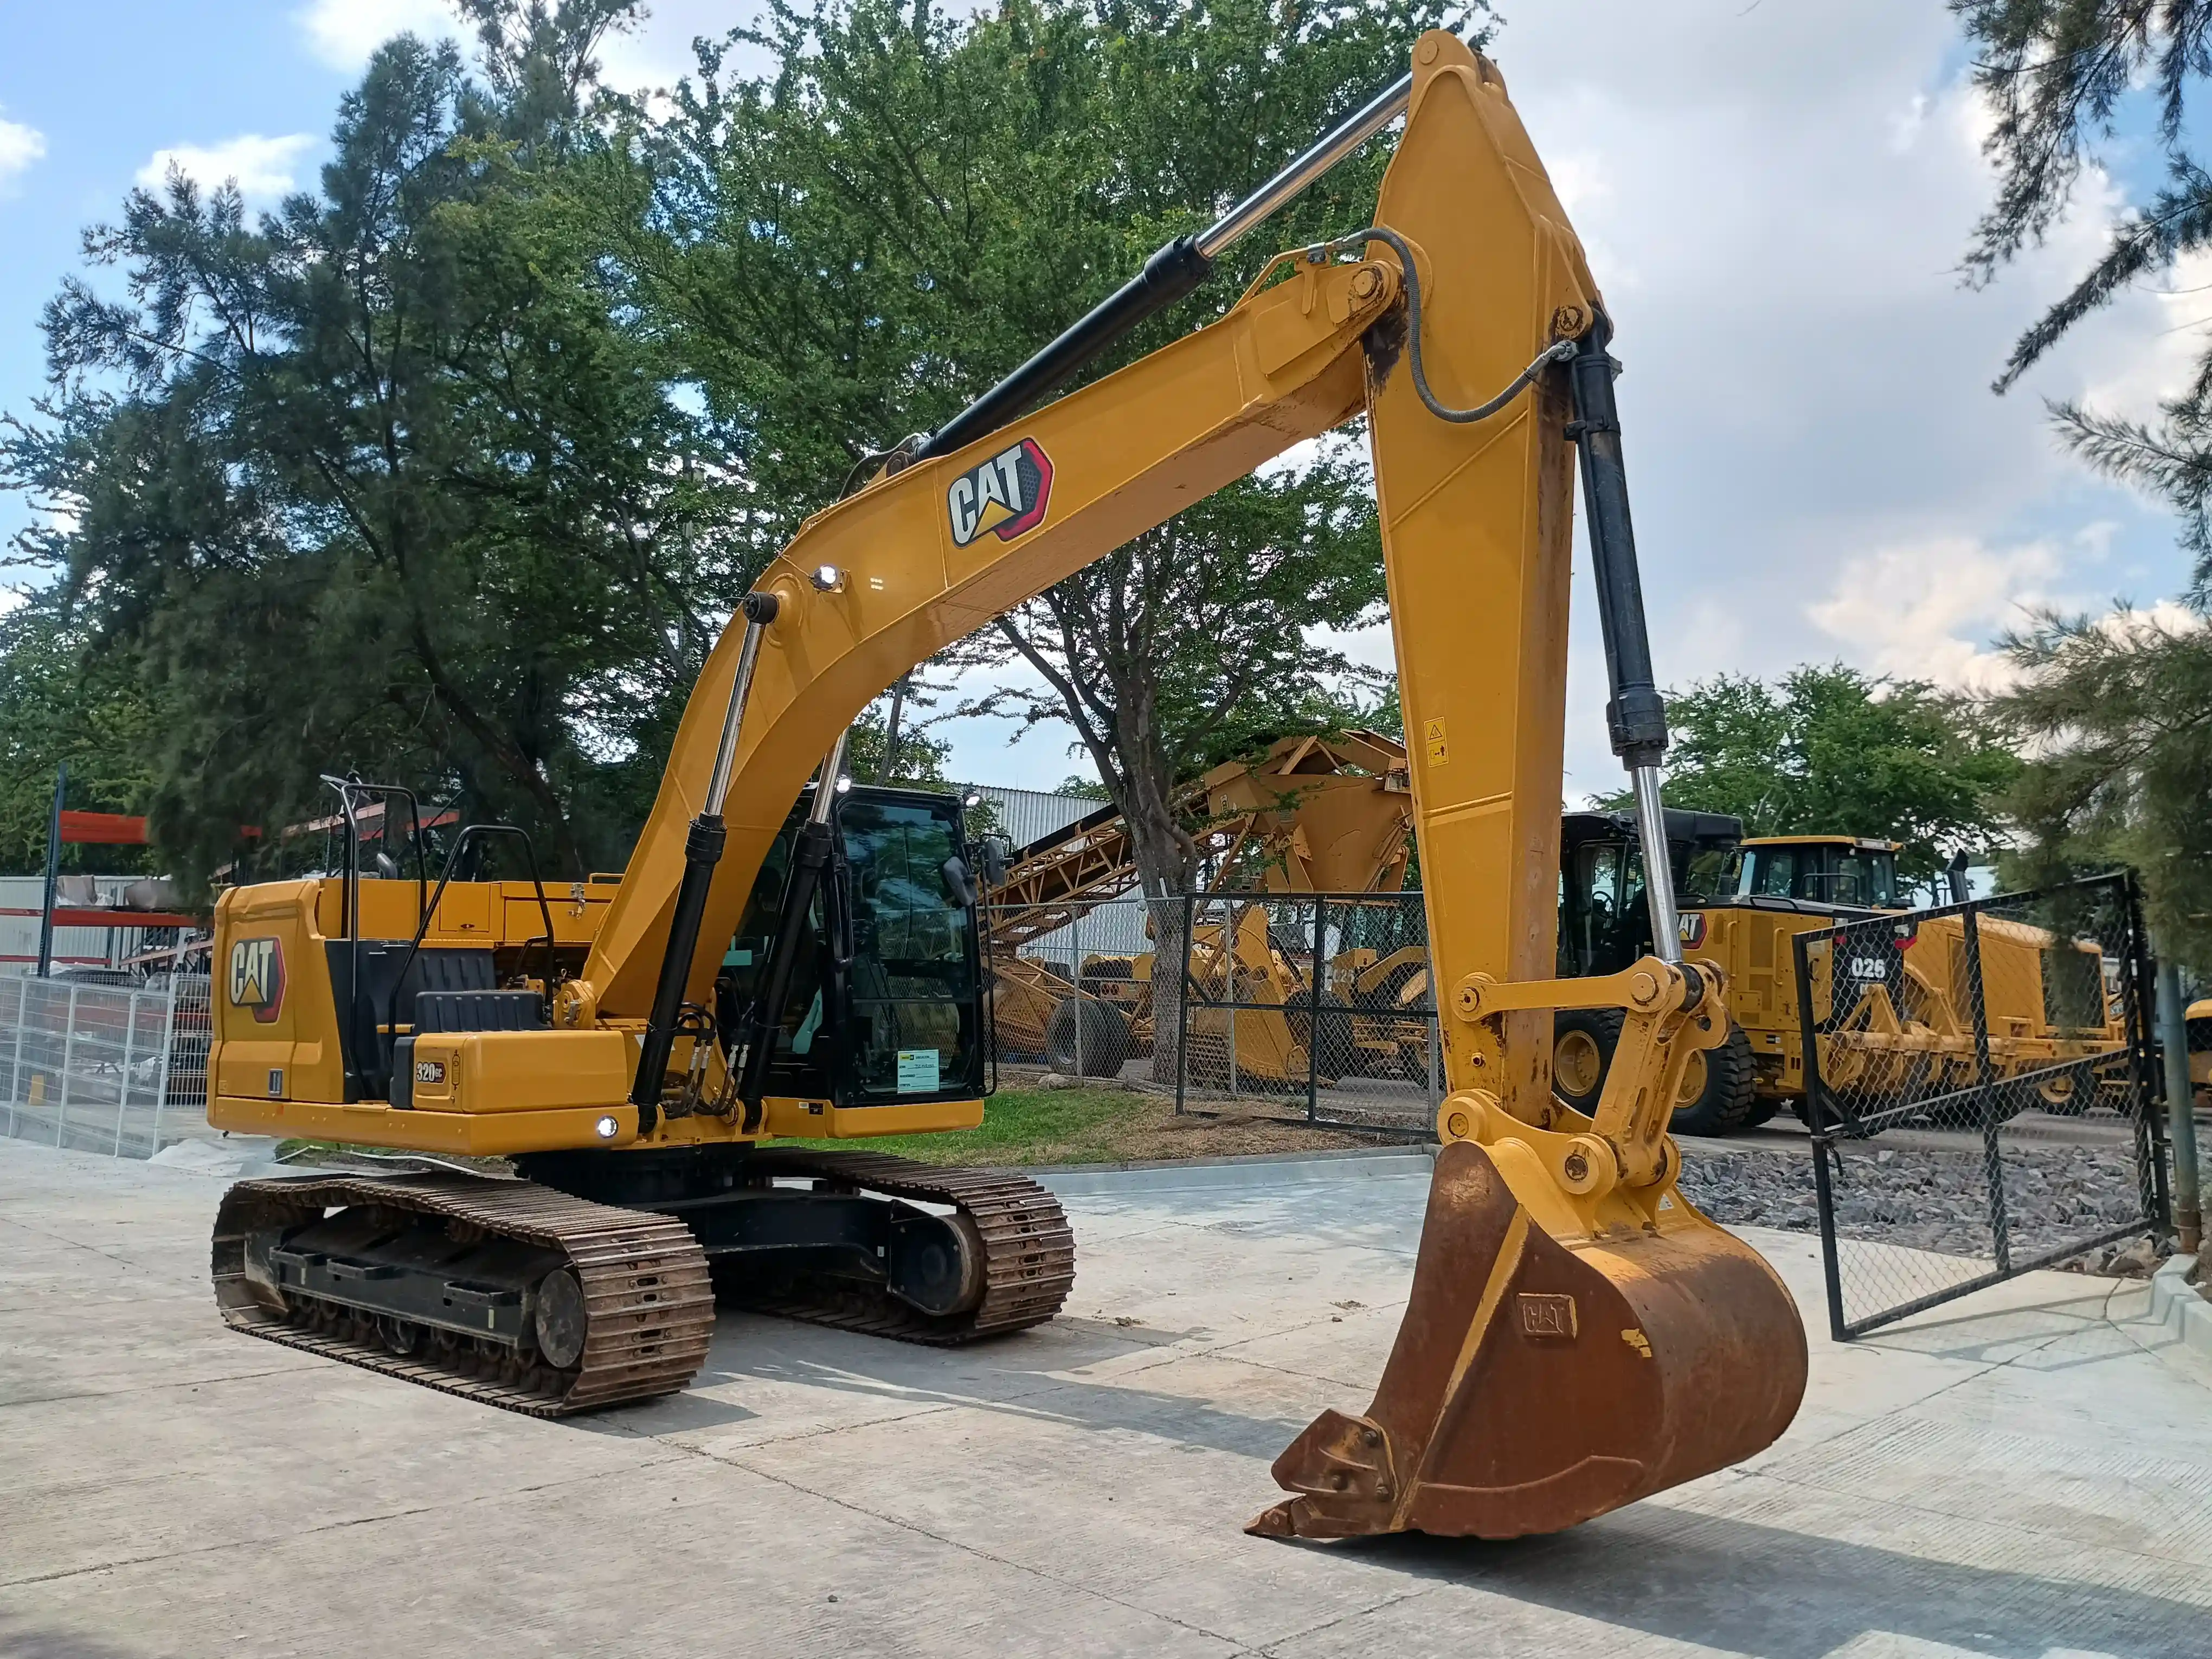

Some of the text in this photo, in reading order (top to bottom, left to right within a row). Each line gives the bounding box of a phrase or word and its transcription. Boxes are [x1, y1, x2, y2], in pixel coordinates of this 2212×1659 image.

[949, 445, 1022, 544] CAT
[1677, 914, 1700, 941] AT
[231, 941, 273, 1004] CAT
[416, 1062, 435, 1082] 320
[1523, 1302, 1568, 1333] CAT
